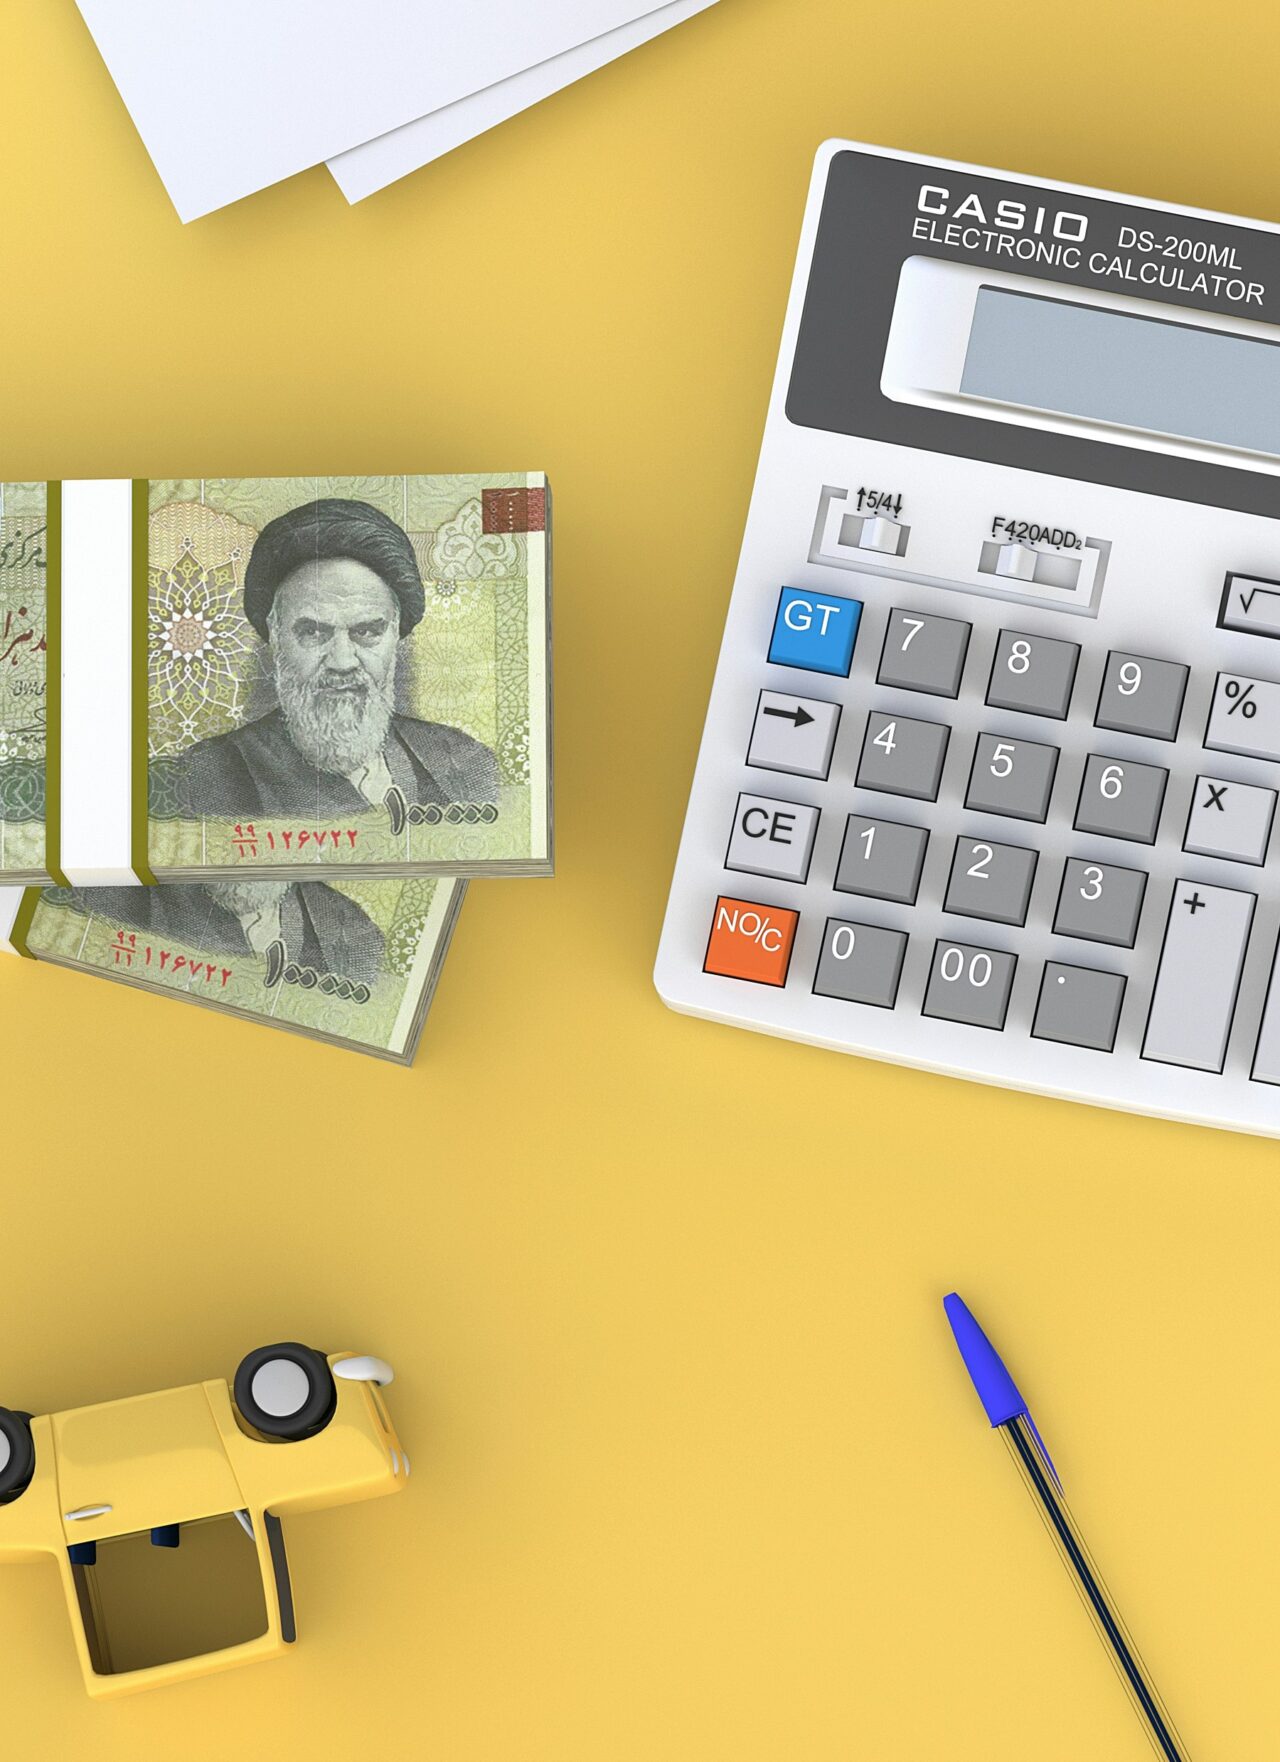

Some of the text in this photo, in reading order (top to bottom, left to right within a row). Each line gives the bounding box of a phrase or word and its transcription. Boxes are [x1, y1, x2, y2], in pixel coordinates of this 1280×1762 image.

[916, 184, 1089, 243] CASIO
[911, 217, 1266, 305] ELECTRONIC CALCULATOR
[1117, 226, 1243, 271] DS-200ML
[784, 599, 841, 636] GT
[901, 618, 925, 651] 7
[1007, 640, 1031, 674] 8
[1117, 662, 1142, 696] 9
[1225, 680, 1257, 719] %
[873, 722, 896, 755] 4
[990, 743, 1015, 778] 5
[1100, 765, 1124, 799] 6
[741, 807, 796, 845] CE
[860, 826, 876, 860] 1
[966, 844, 993, 879] 2
[1080, 866, 1104, 900] 3
[1183, 892, 1206, 915] +
[715, 906, 783, 953] NO/C
[831, 926, 855, 960] 0
[940, 947, 992, 987] 00
